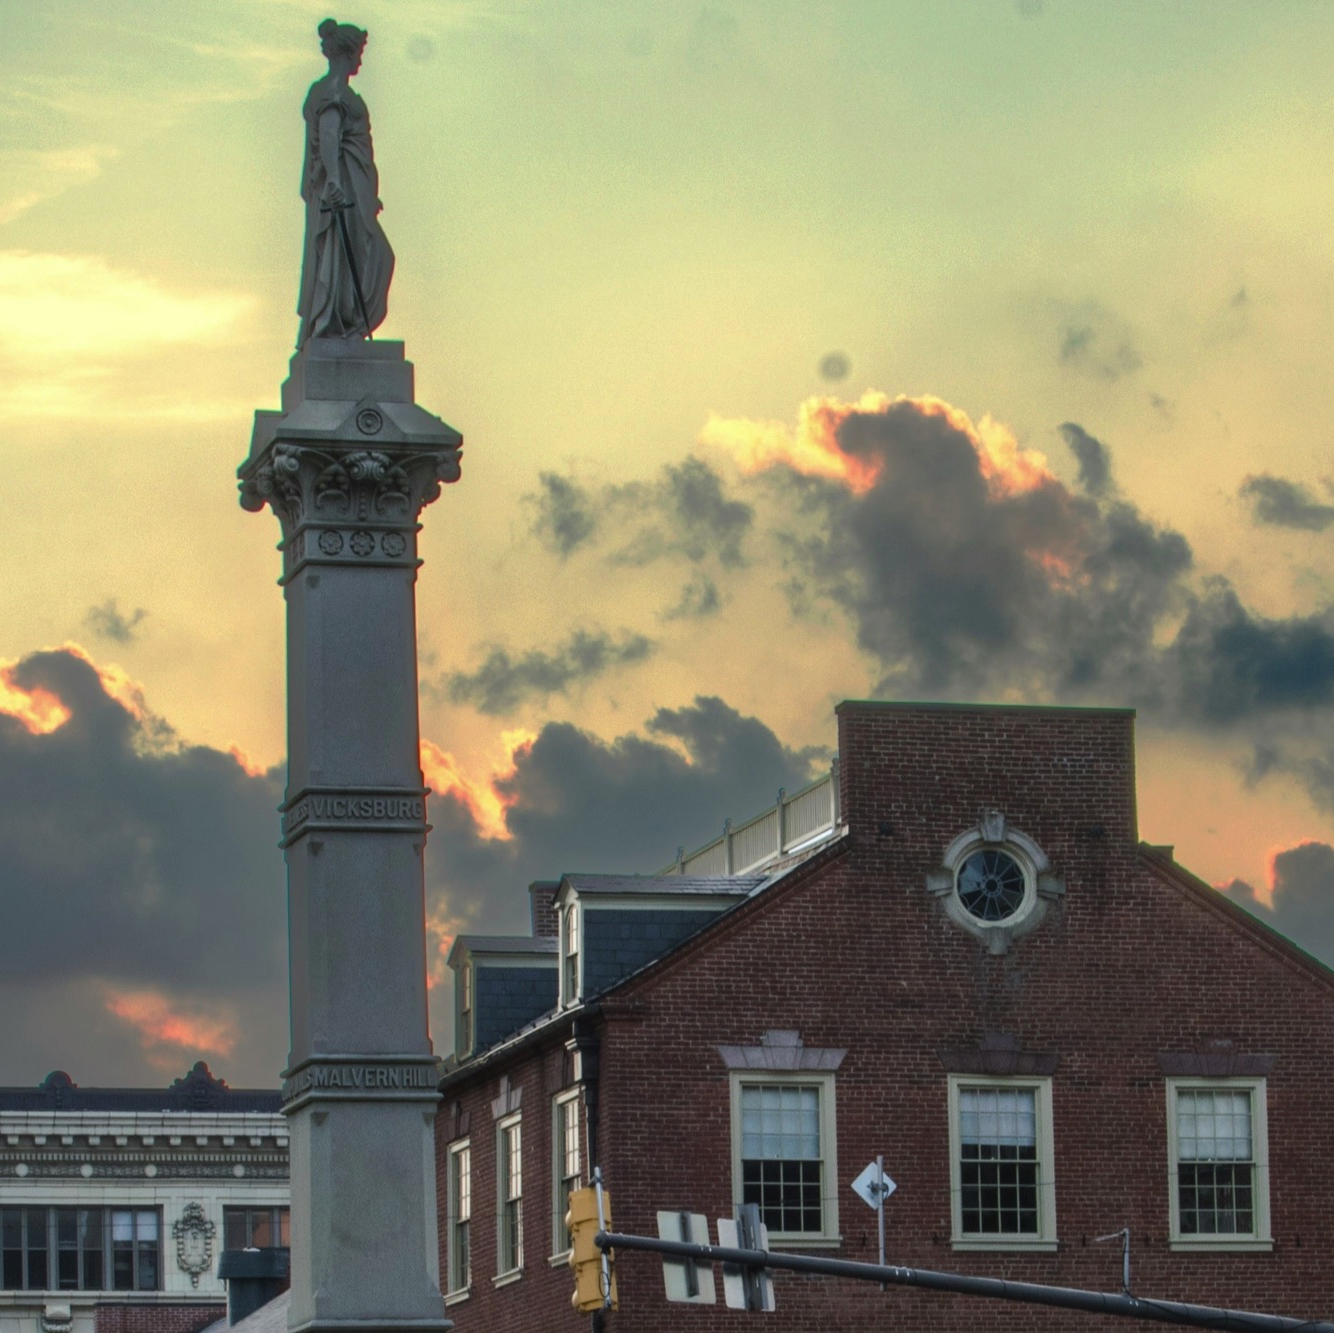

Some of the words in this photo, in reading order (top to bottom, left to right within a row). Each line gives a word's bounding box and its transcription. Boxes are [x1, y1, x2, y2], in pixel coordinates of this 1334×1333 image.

[312, 798, 422, 819] VICKSBURG
[314, 1068, 399, 1088] MALVERN
[402, 1068, 437, 1089] HILL
